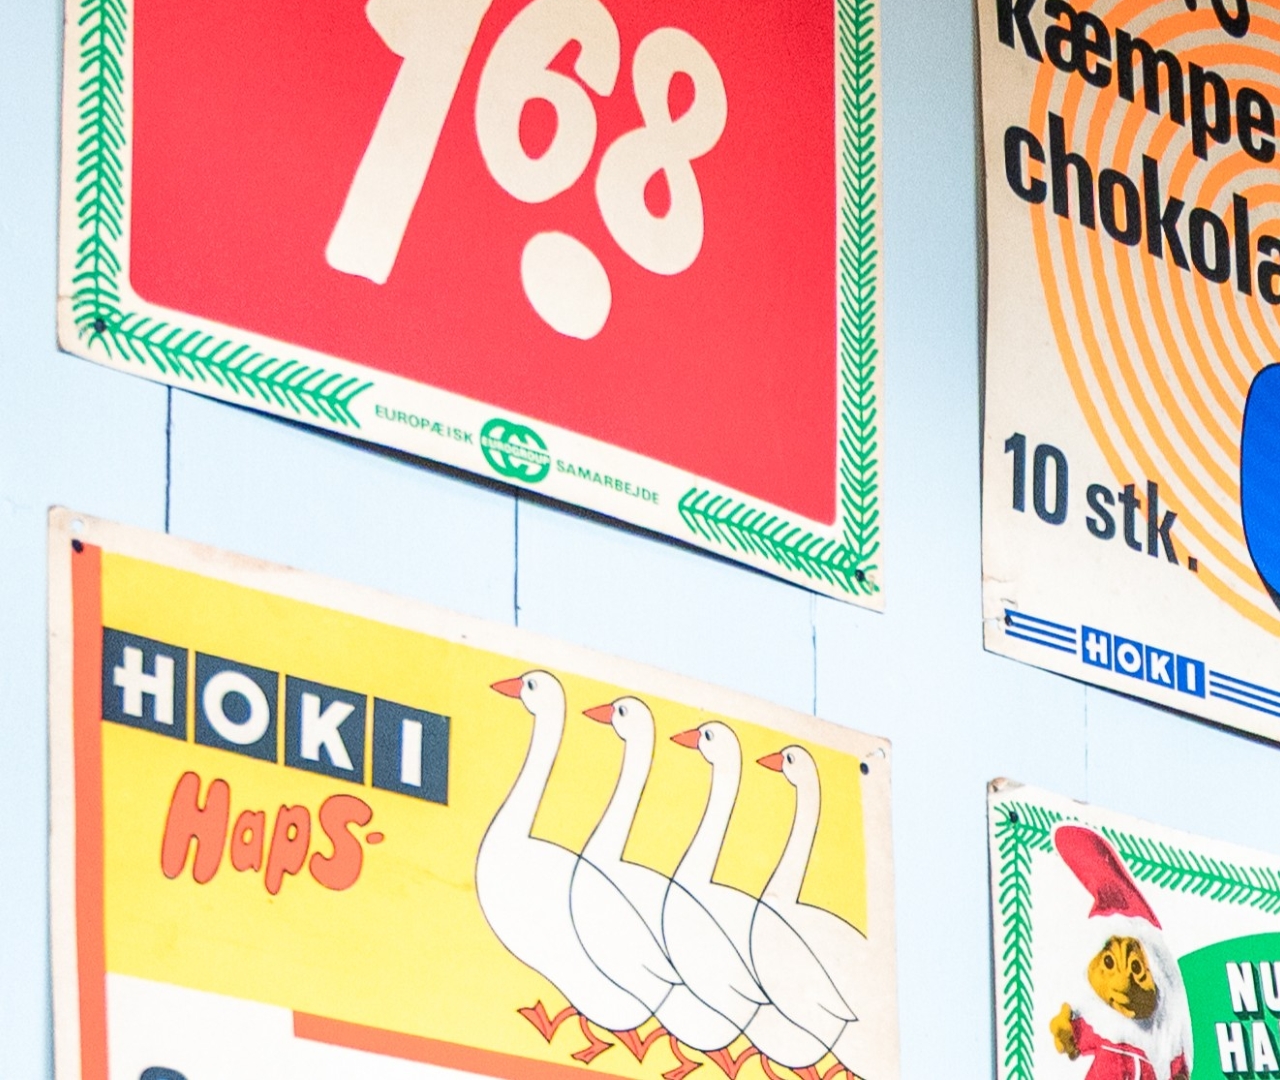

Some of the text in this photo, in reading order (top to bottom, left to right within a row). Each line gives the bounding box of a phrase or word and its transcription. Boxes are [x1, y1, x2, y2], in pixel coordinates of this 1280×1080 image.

[375, 404, 474, 444] EUROPÆISK
[556, 459, 660, 505] SAMARBEJDE
[1004, 432, 1199, 574] 10 stk.
[114, 646, 422, 787] HOKI
[1083, 630, 1198, 696] HOKI
